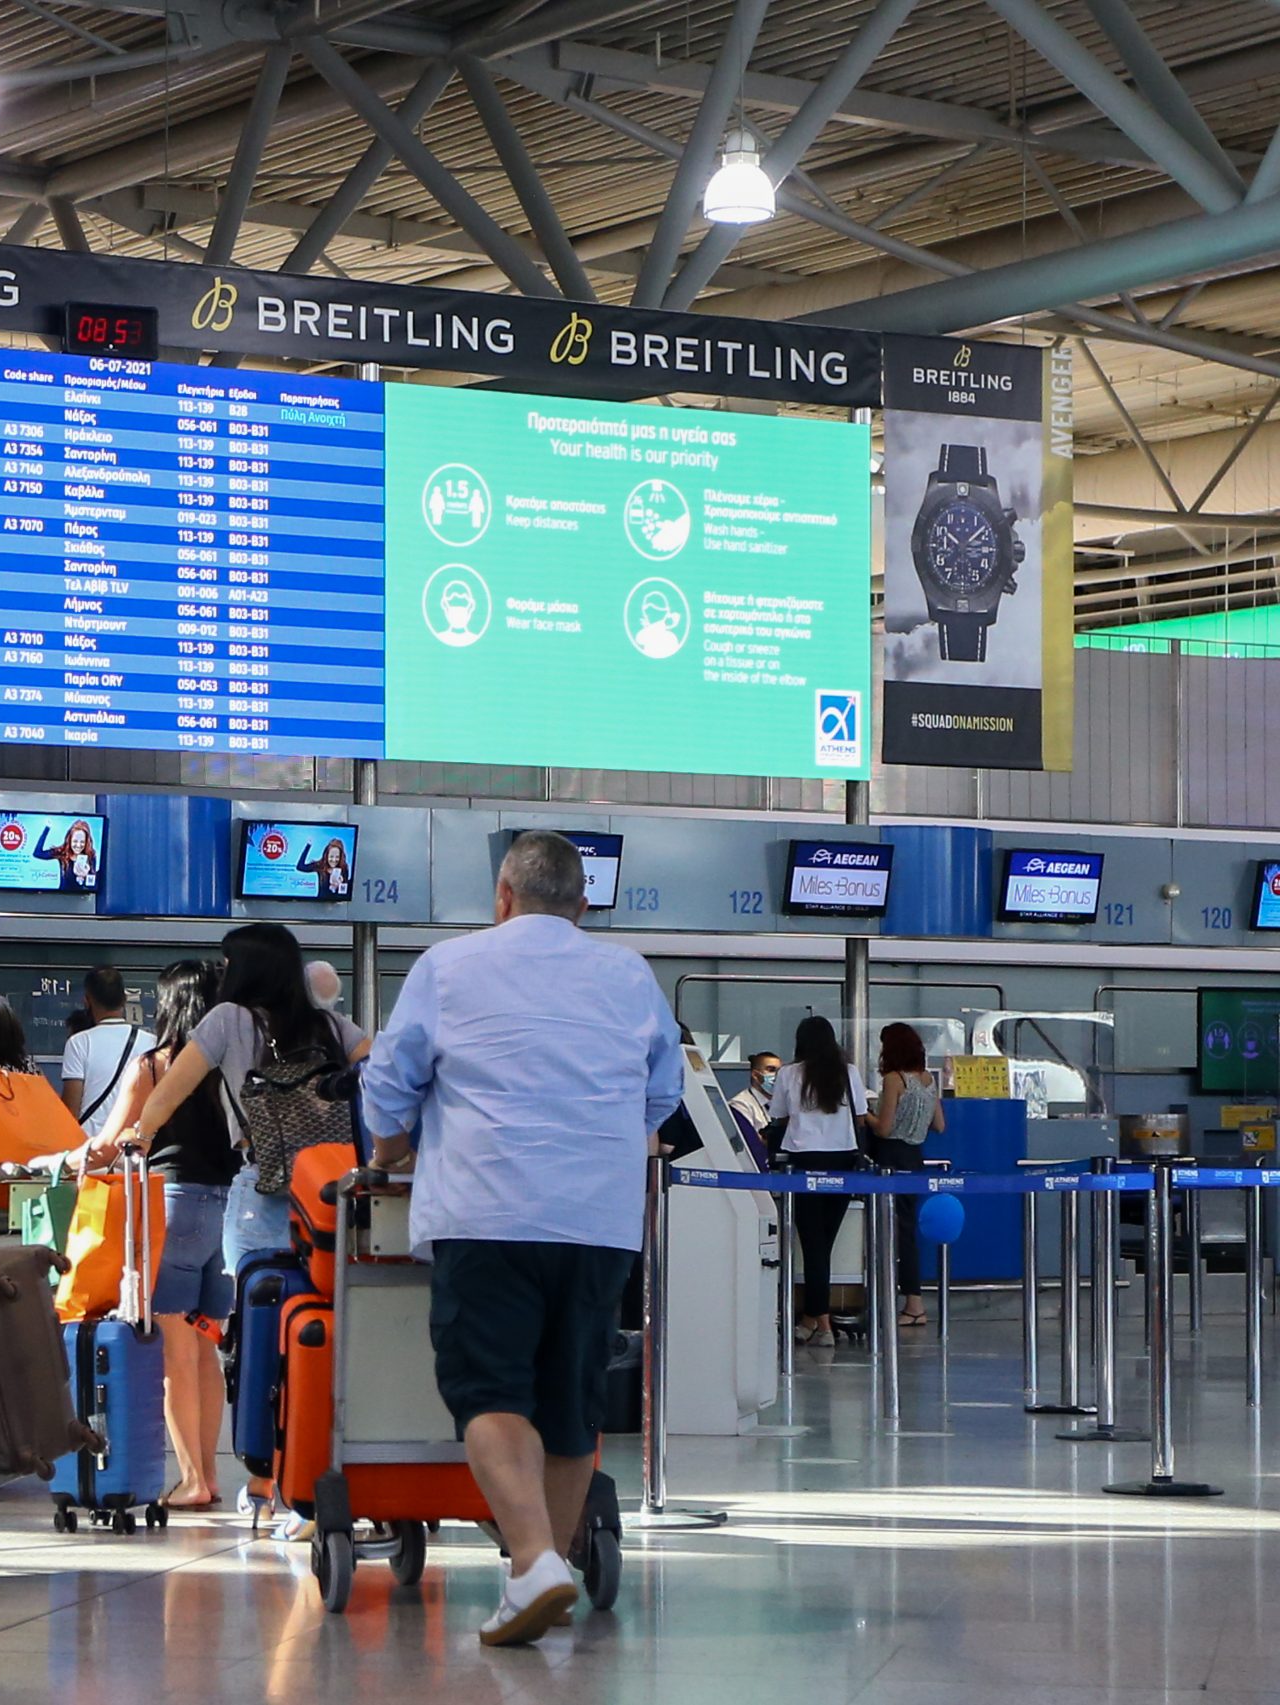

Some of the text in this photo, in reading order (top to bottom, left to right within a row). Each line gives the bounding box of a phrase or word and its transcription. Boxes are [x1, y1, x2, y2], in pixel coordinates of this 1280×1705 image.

[258, 296, 515, 354] BREITLING
[90, 358, 150, 374] 06-07-2021
[611, 331, 848, 385] BREITLING
[4, 370, 26, 379] Code
[29, 372, 53, 381] share
[913, 368, 1013, 391] BREITLING
[948, 390, 976, 404] 1884
[4, 443, 17, 454] A3
[19, 443, 42, 455] 7354
[64, 446, 116, 465] Σαντορίνη
[178, 456, 214, 469] 113-139
[229, 460, 268, 473] B03-B31
[550, 438, 719, 470] Your health is our priority
[446, 480, 469, 499] 1.5
[64, 672, 99, 687] Παρίσι
[101, 674, 123, 686] ORY
[178, 679, 217, 691] 050-053
[229, 681, 268, 694] B03-B31
[911, 713, 1014, 732] #SQUADONAMISSION
[833, 853, 879, 867] AEGEAN
[1045, 862, 1090, 875] AEGEAN
[362, 879, 399, 903] 124
[624, 887, 659, 911] 123
[729, 890, 763, 914] 122
[1104, 903, 1134, 925] 121
[1201, 907, 1232, 929] 120
[690, 1171, 718, 1180] ATHENS
[816, 1177, 844, 1185] ATHENS
[938, 1177, 965, 1186] ATHENS
[1054, 1175, 1079, 1185] ATHENS
[1178, 1169, 1199, 1178] ATHENS
